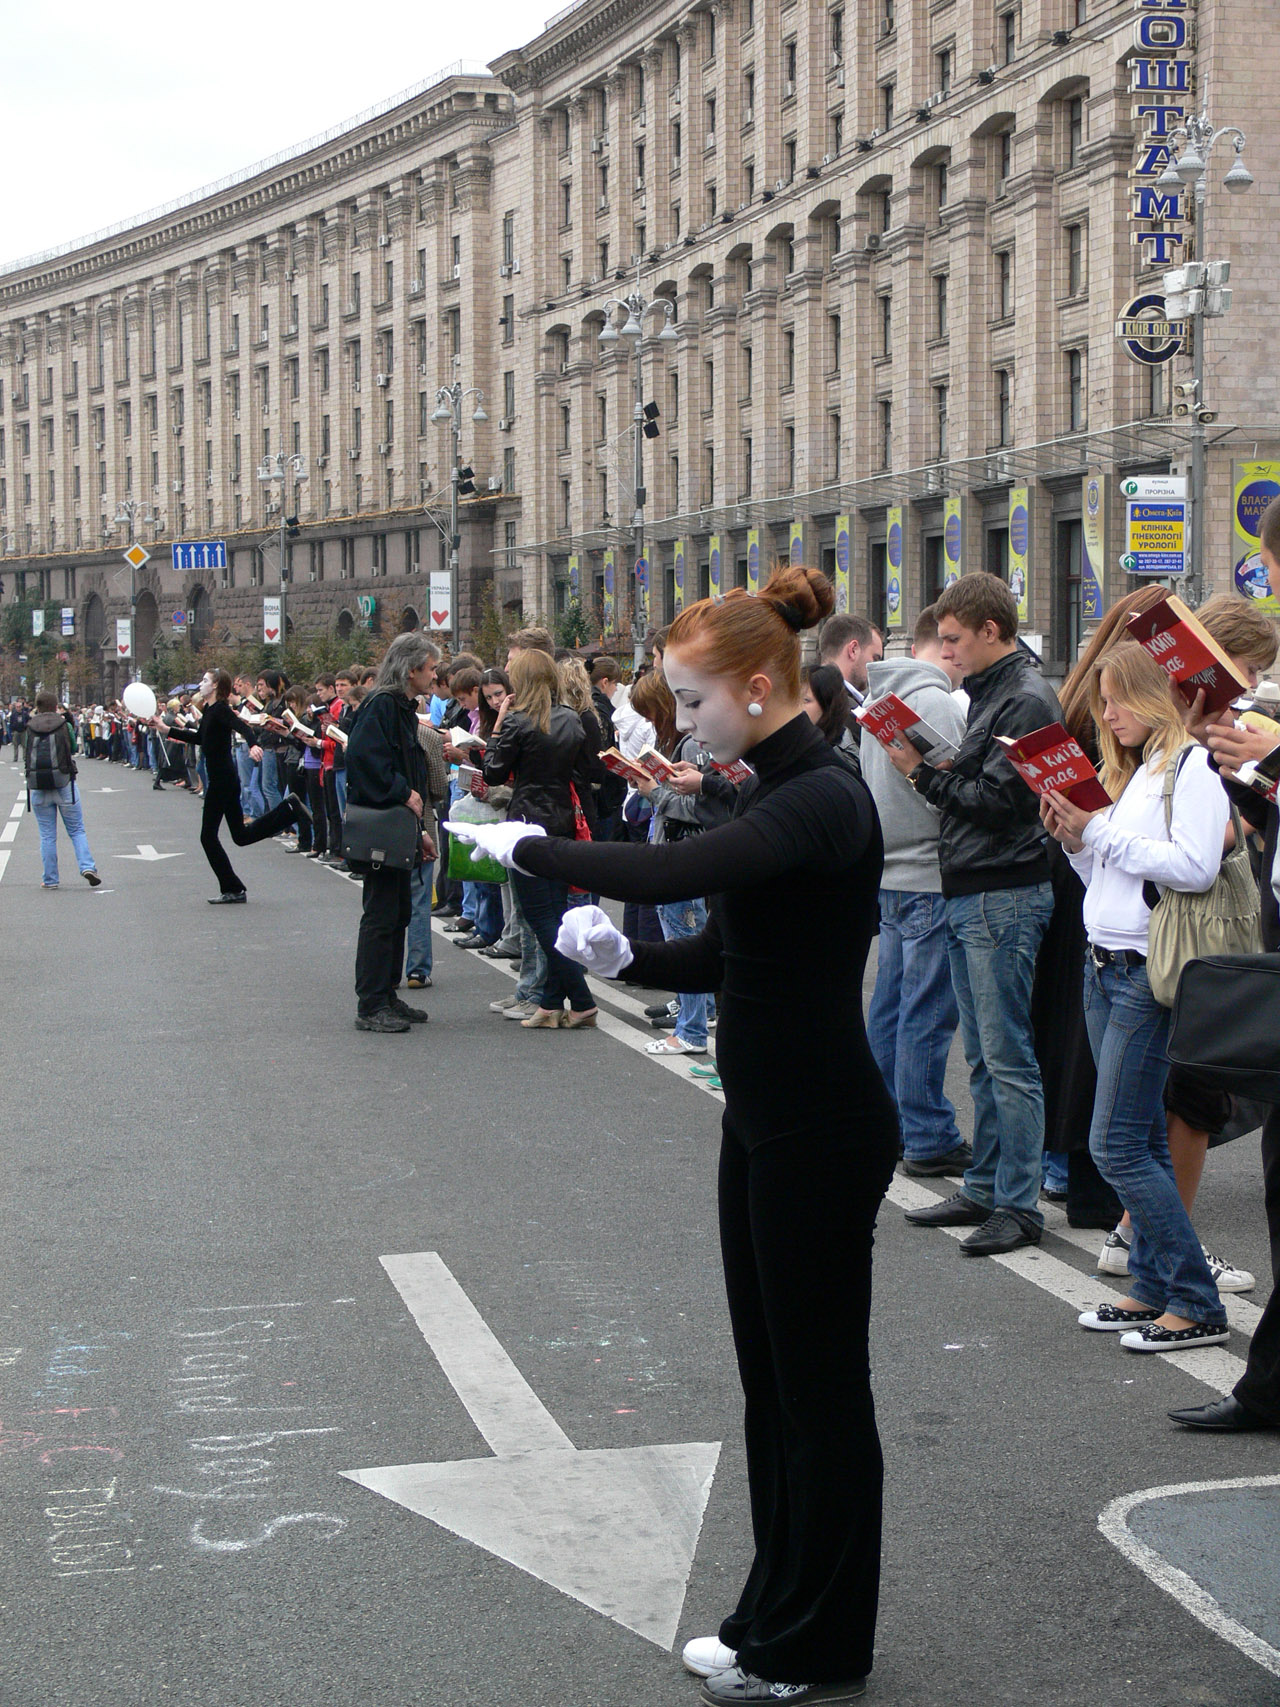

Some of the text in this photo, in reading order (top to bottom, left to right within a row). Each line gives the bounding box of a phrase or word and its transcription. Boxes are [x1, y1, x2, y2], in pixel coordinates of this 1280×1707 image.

[1128, 0, 1192, 265] ОШТАМТ
[1241, 495, 1275, 505] ВЛАСН
[1243, 506, 1266, 516] МАР
[1132, 531, 1182, 540] ГІНЕКОЛОГІЇ
[1138, 541, 1176, 549] УРОЛОГІЇ
